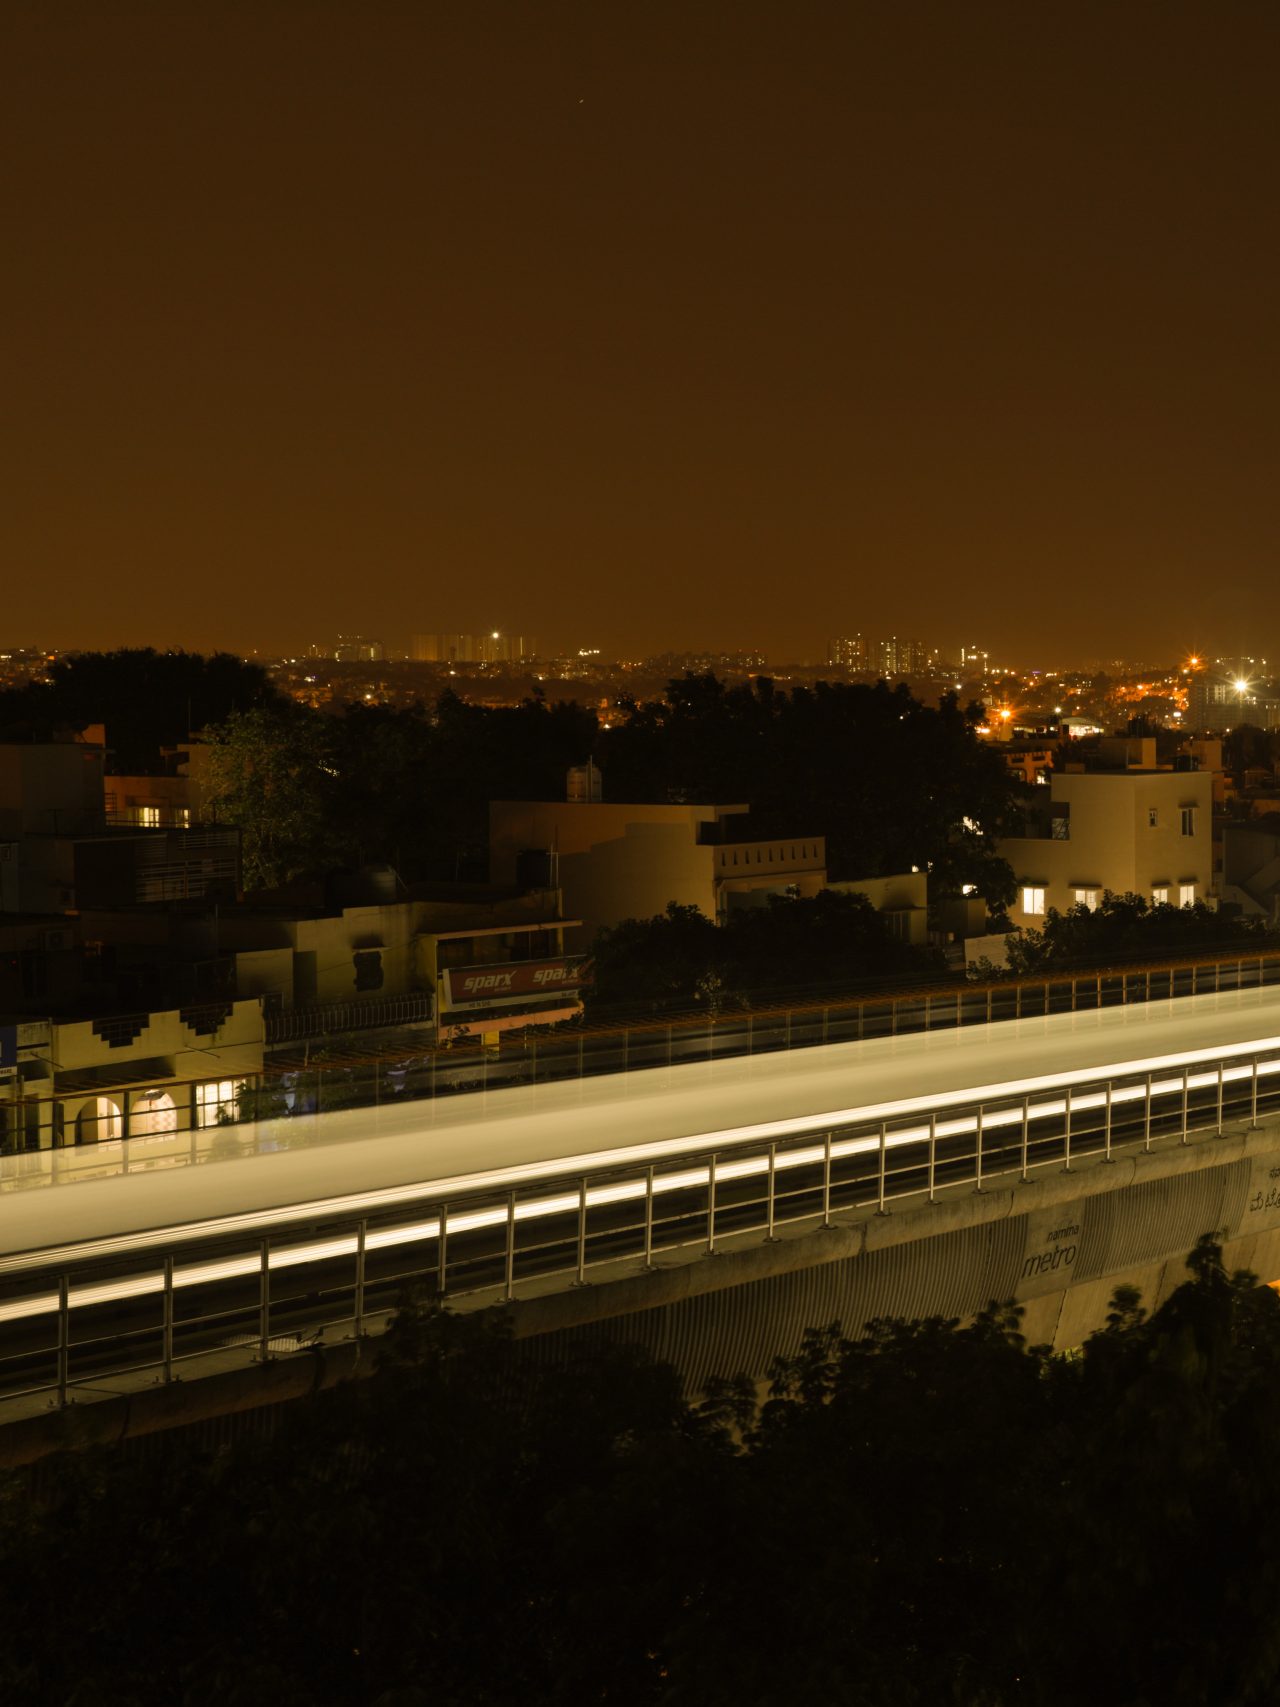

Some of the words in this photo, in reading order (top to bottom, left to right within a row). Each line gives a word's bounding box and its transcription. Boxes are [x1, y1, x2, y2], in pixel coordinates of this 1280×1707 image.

[463, 970, 517, 993] sparx
[1047, 1225, 1079, 1242] namma
[1021, 1245, 1077, 1278] metro
